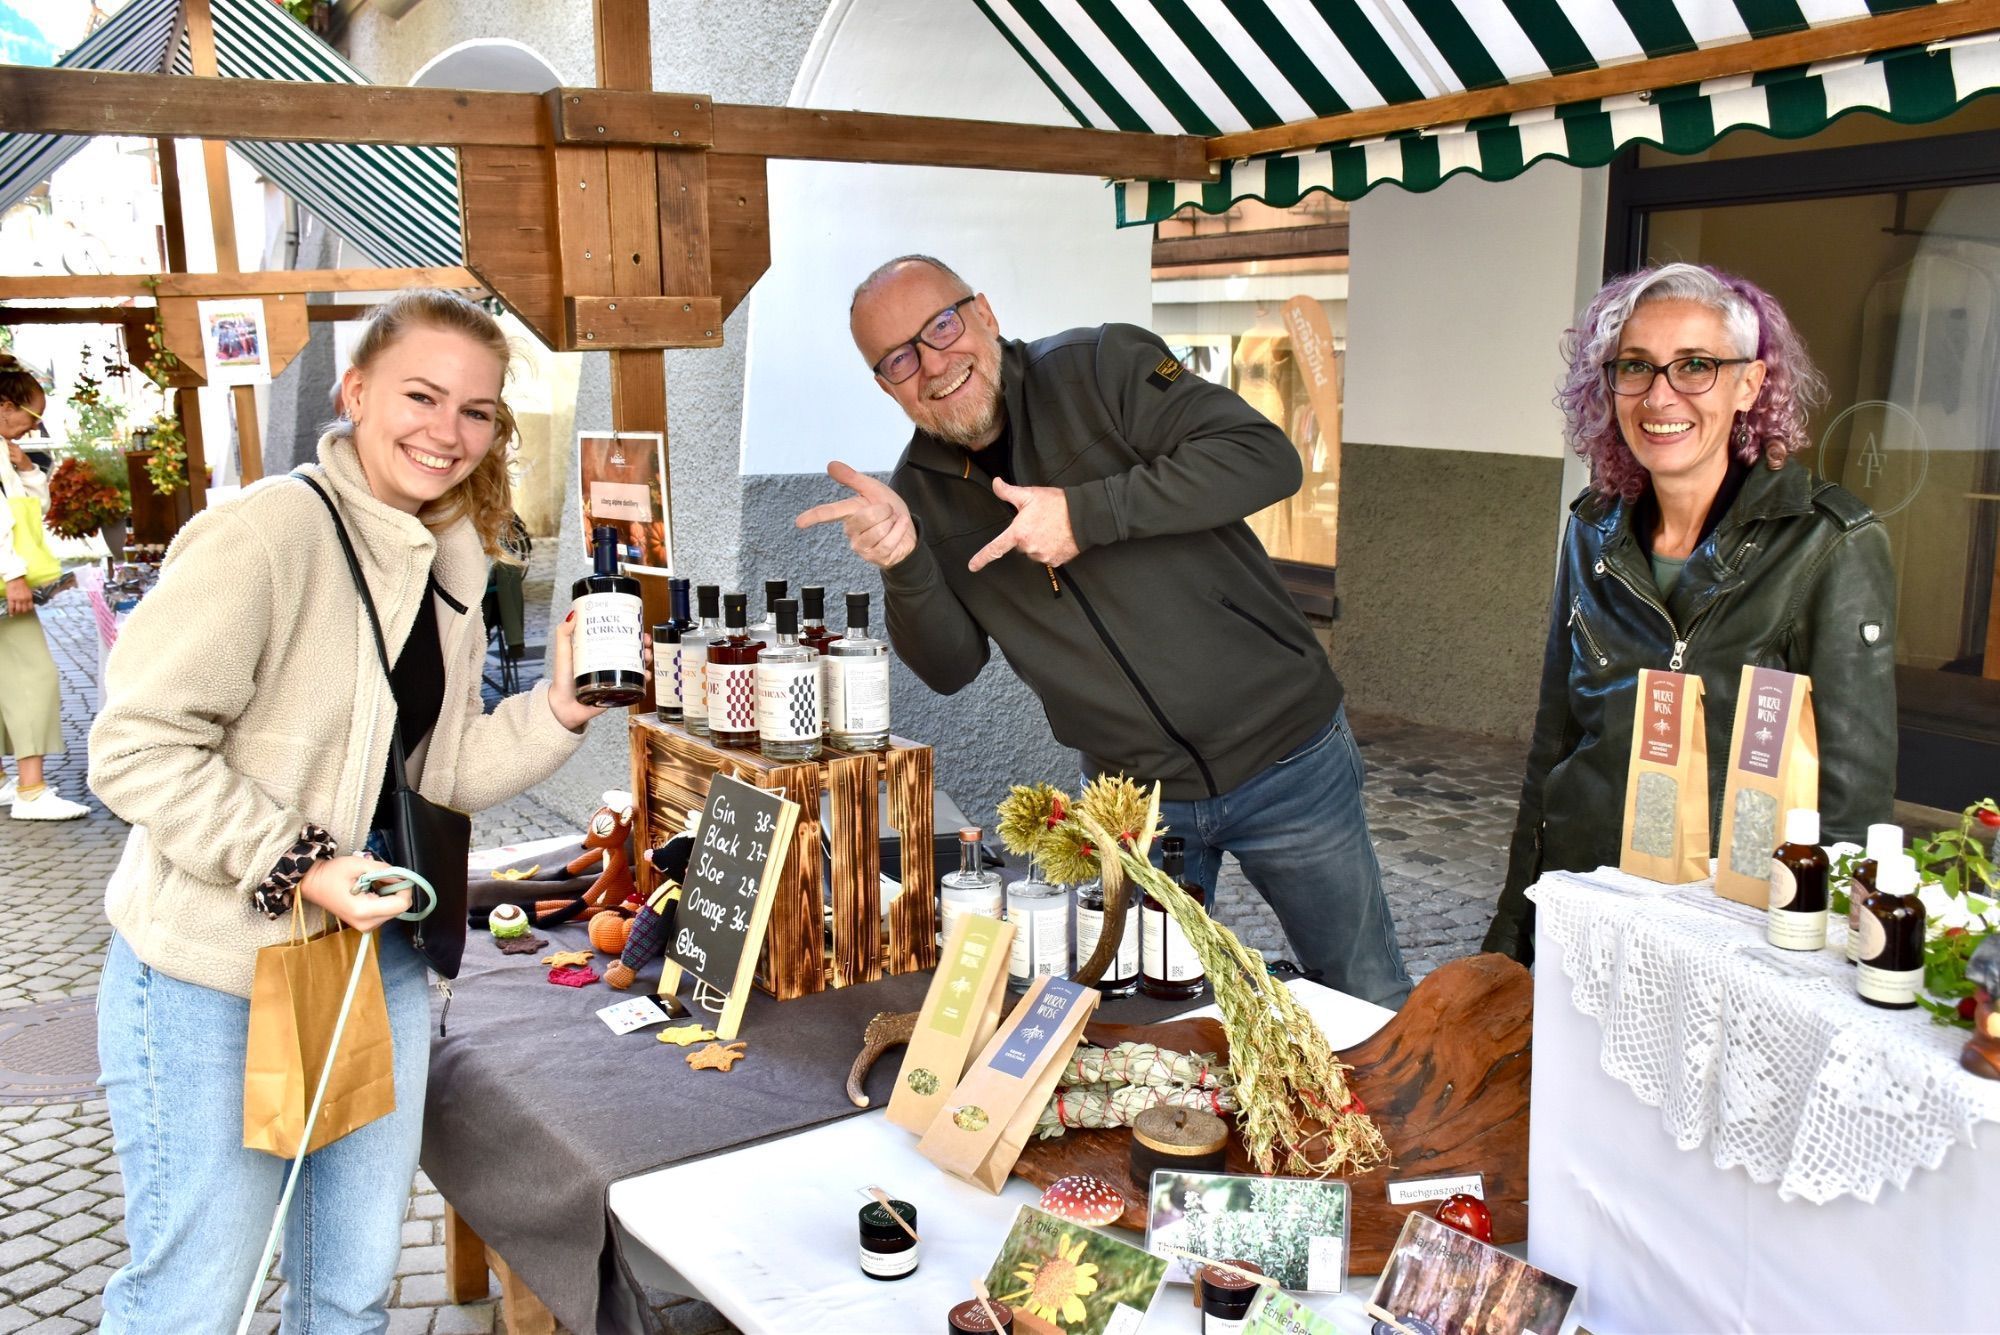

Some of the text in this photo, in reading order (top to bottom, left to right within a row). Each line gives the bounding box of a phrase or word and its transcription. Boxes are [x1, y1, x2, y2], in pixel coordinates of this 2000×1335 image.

[586, 616, 620, 625] BLACK
[586, 626, 634, 636] CURRANT
[711, 795, 736, 825] Gin
[703, 824, 741, 858] Black
[696, 852, 725, 885] Sloe
[687, 887, 726, 932] Orange
[1474, 1183, 1481, 1192] €
[1262, 1302, 1293, 1328] Echter
[1292, 1320, 1312, 1335] Bei
